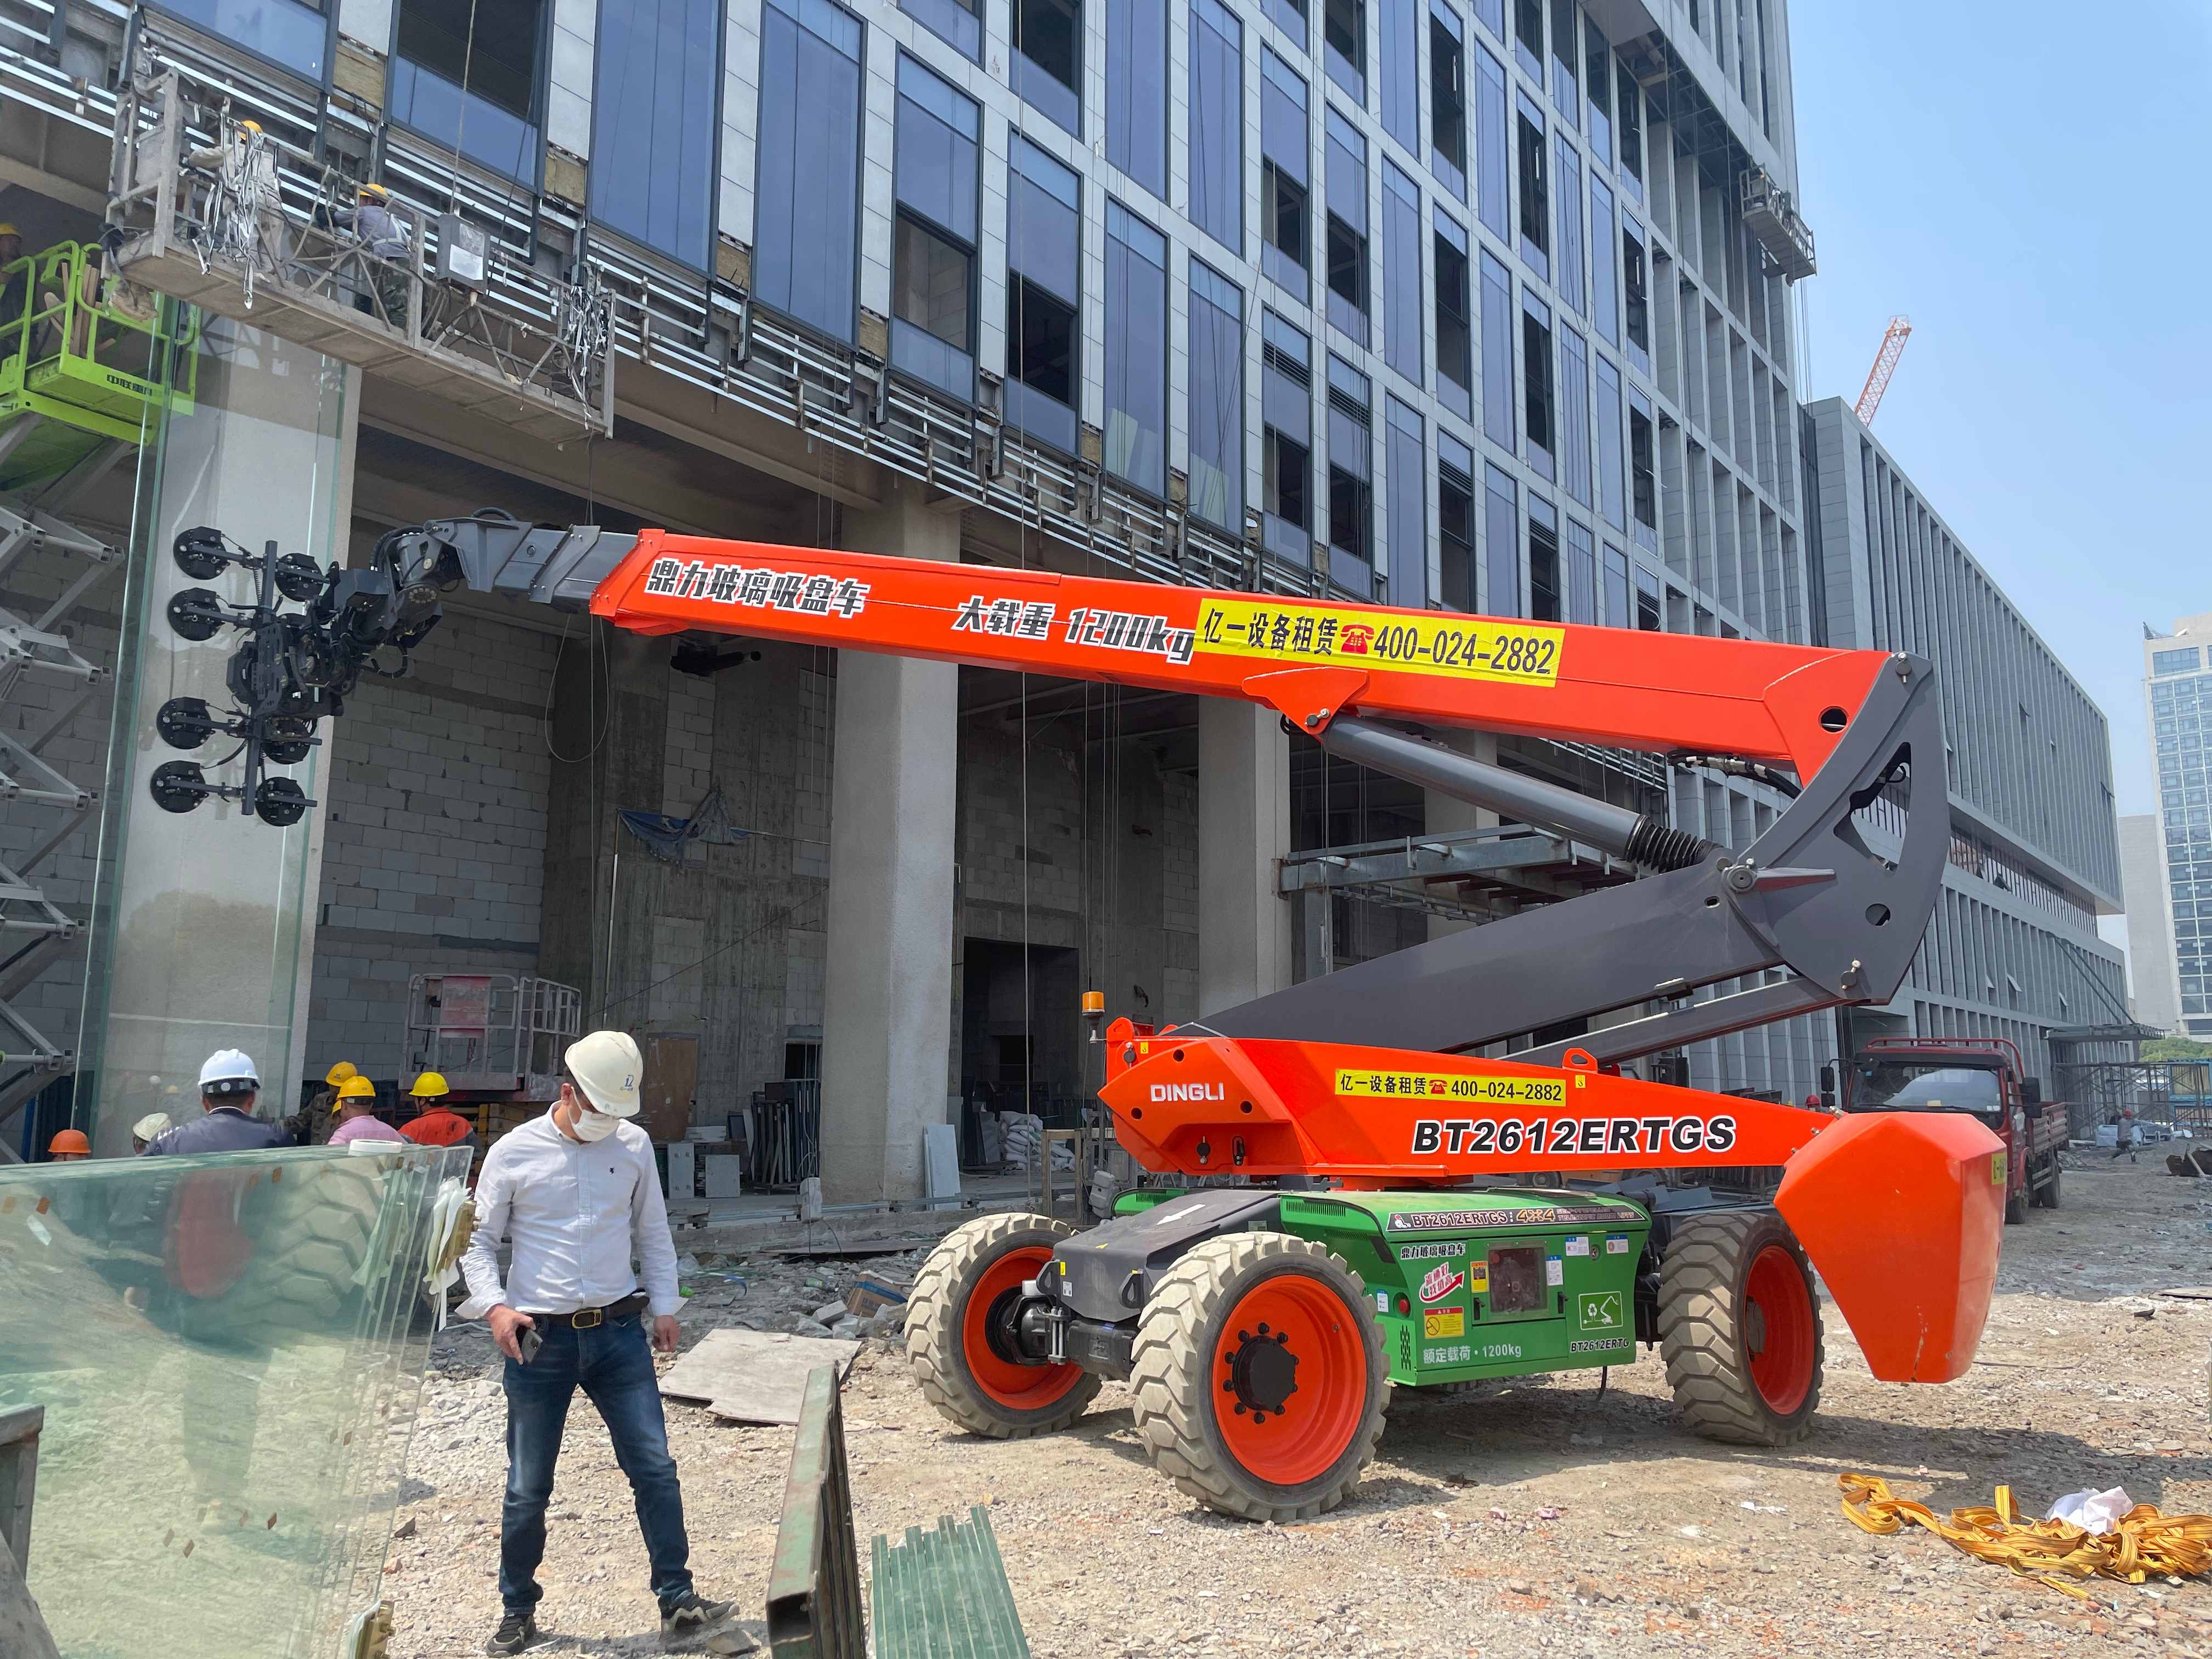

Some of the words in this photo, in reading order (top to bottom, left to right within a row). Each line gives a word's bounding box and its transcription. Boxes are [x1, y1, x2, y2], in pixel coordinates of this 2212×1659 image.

[645, 558, 871, 617] 鼎力玻璃吸盘车
[952, 596, 1055, 639] 大载重
[1065, 608, 1195, 664] 1200kg
[1204, 607, 1338, 656] 亿一设备租赁
[1374, 625, 1554, 674] 400-024-2882
[1150, 1082, 1224, 1102] DINGLI
[1341, 1074, 1426, 1095] 亿一设备租赁
[1452, 1080, 1562, 1101] 400-024-2882
[1412, 1116, 1735, 1153] BT2612ERTGS
[1411, 1211, 1508, 1227] BT2612ERTGS
[1401, 1242, 1466, 1260] 鼎力玻璃吸盘车
[1423, 1345, 1470, 1363] 额定载荷
[1482, 1344, 1521, 1357] 1200kg
